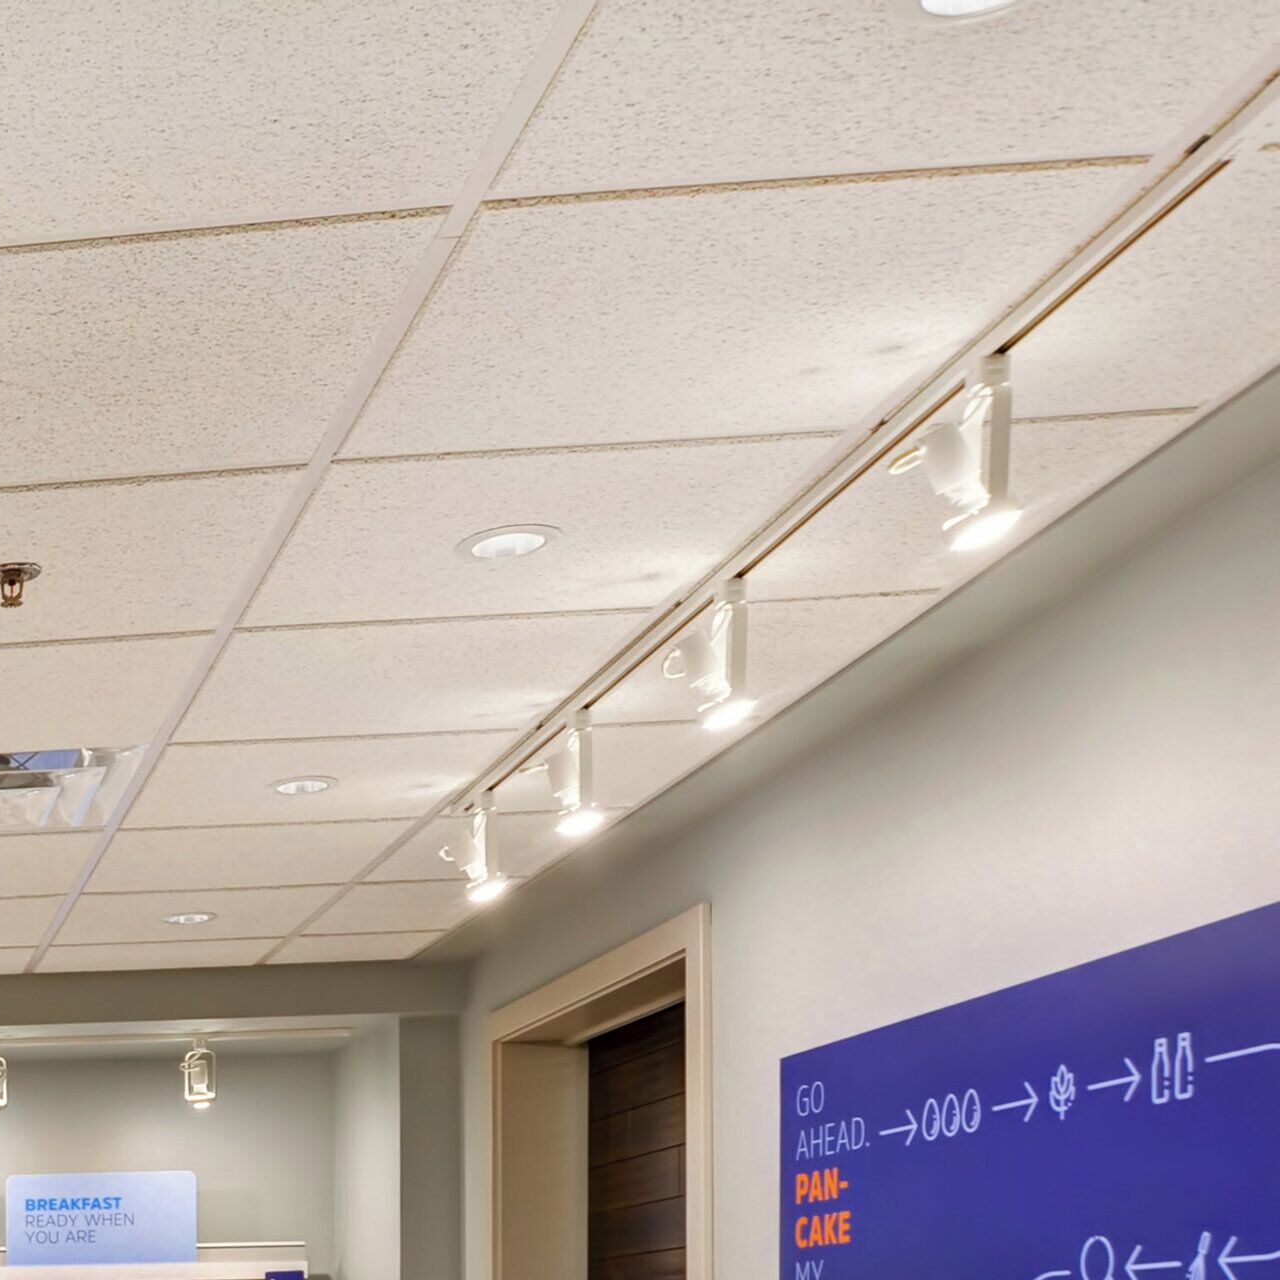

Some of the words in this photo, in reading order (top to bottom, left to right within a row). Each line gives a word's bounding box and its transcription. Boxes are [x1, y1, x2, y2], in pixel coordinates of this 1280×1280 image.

[796, 1081, 825, 1116] GO
[795, 1117, 870, 1161] AHEAD.
[795, 1167, 849, 1205] PAN-
[25, 1197, 122, 1211] BREAKFAST
[25, 1214, 78, 1228] READY
[84, 1213, 135, 1226] WHEN
[26, 1230, 59, 1244] YOU
[65, 1230, 96, 1243] ARE
[795, 1210, 852, 1248] CAKE
